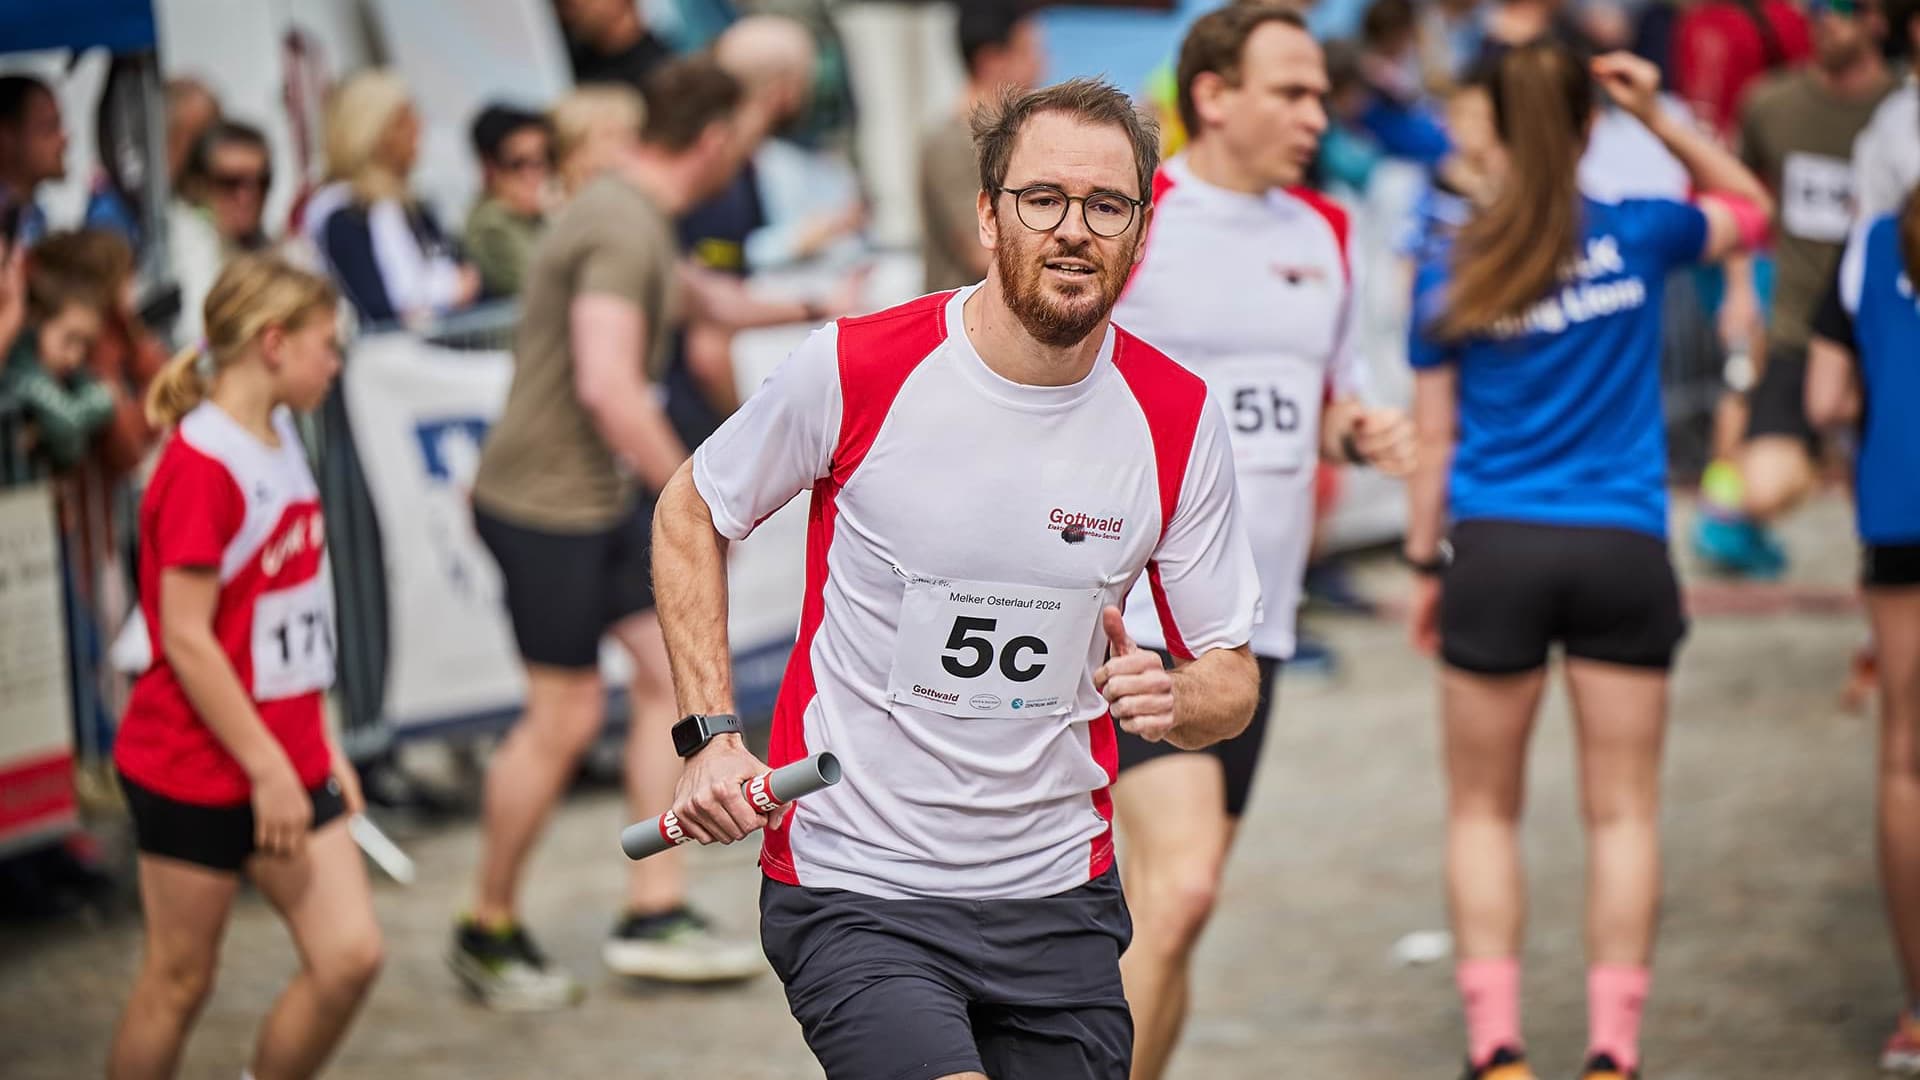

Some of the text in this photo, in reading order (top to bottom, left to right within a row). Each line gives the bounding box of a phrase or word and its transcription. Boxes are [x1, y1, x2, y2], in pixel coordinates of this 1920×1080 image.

[1233, 387, 1299, 433] 5b
[1049, 508, 1124, 533] Gottwald
[949, 592, 1062, 611] Melker Osterlauf 2024
[941, 616, 1048, 682] 5c
[913, 685, 960, 702] Gottwald
